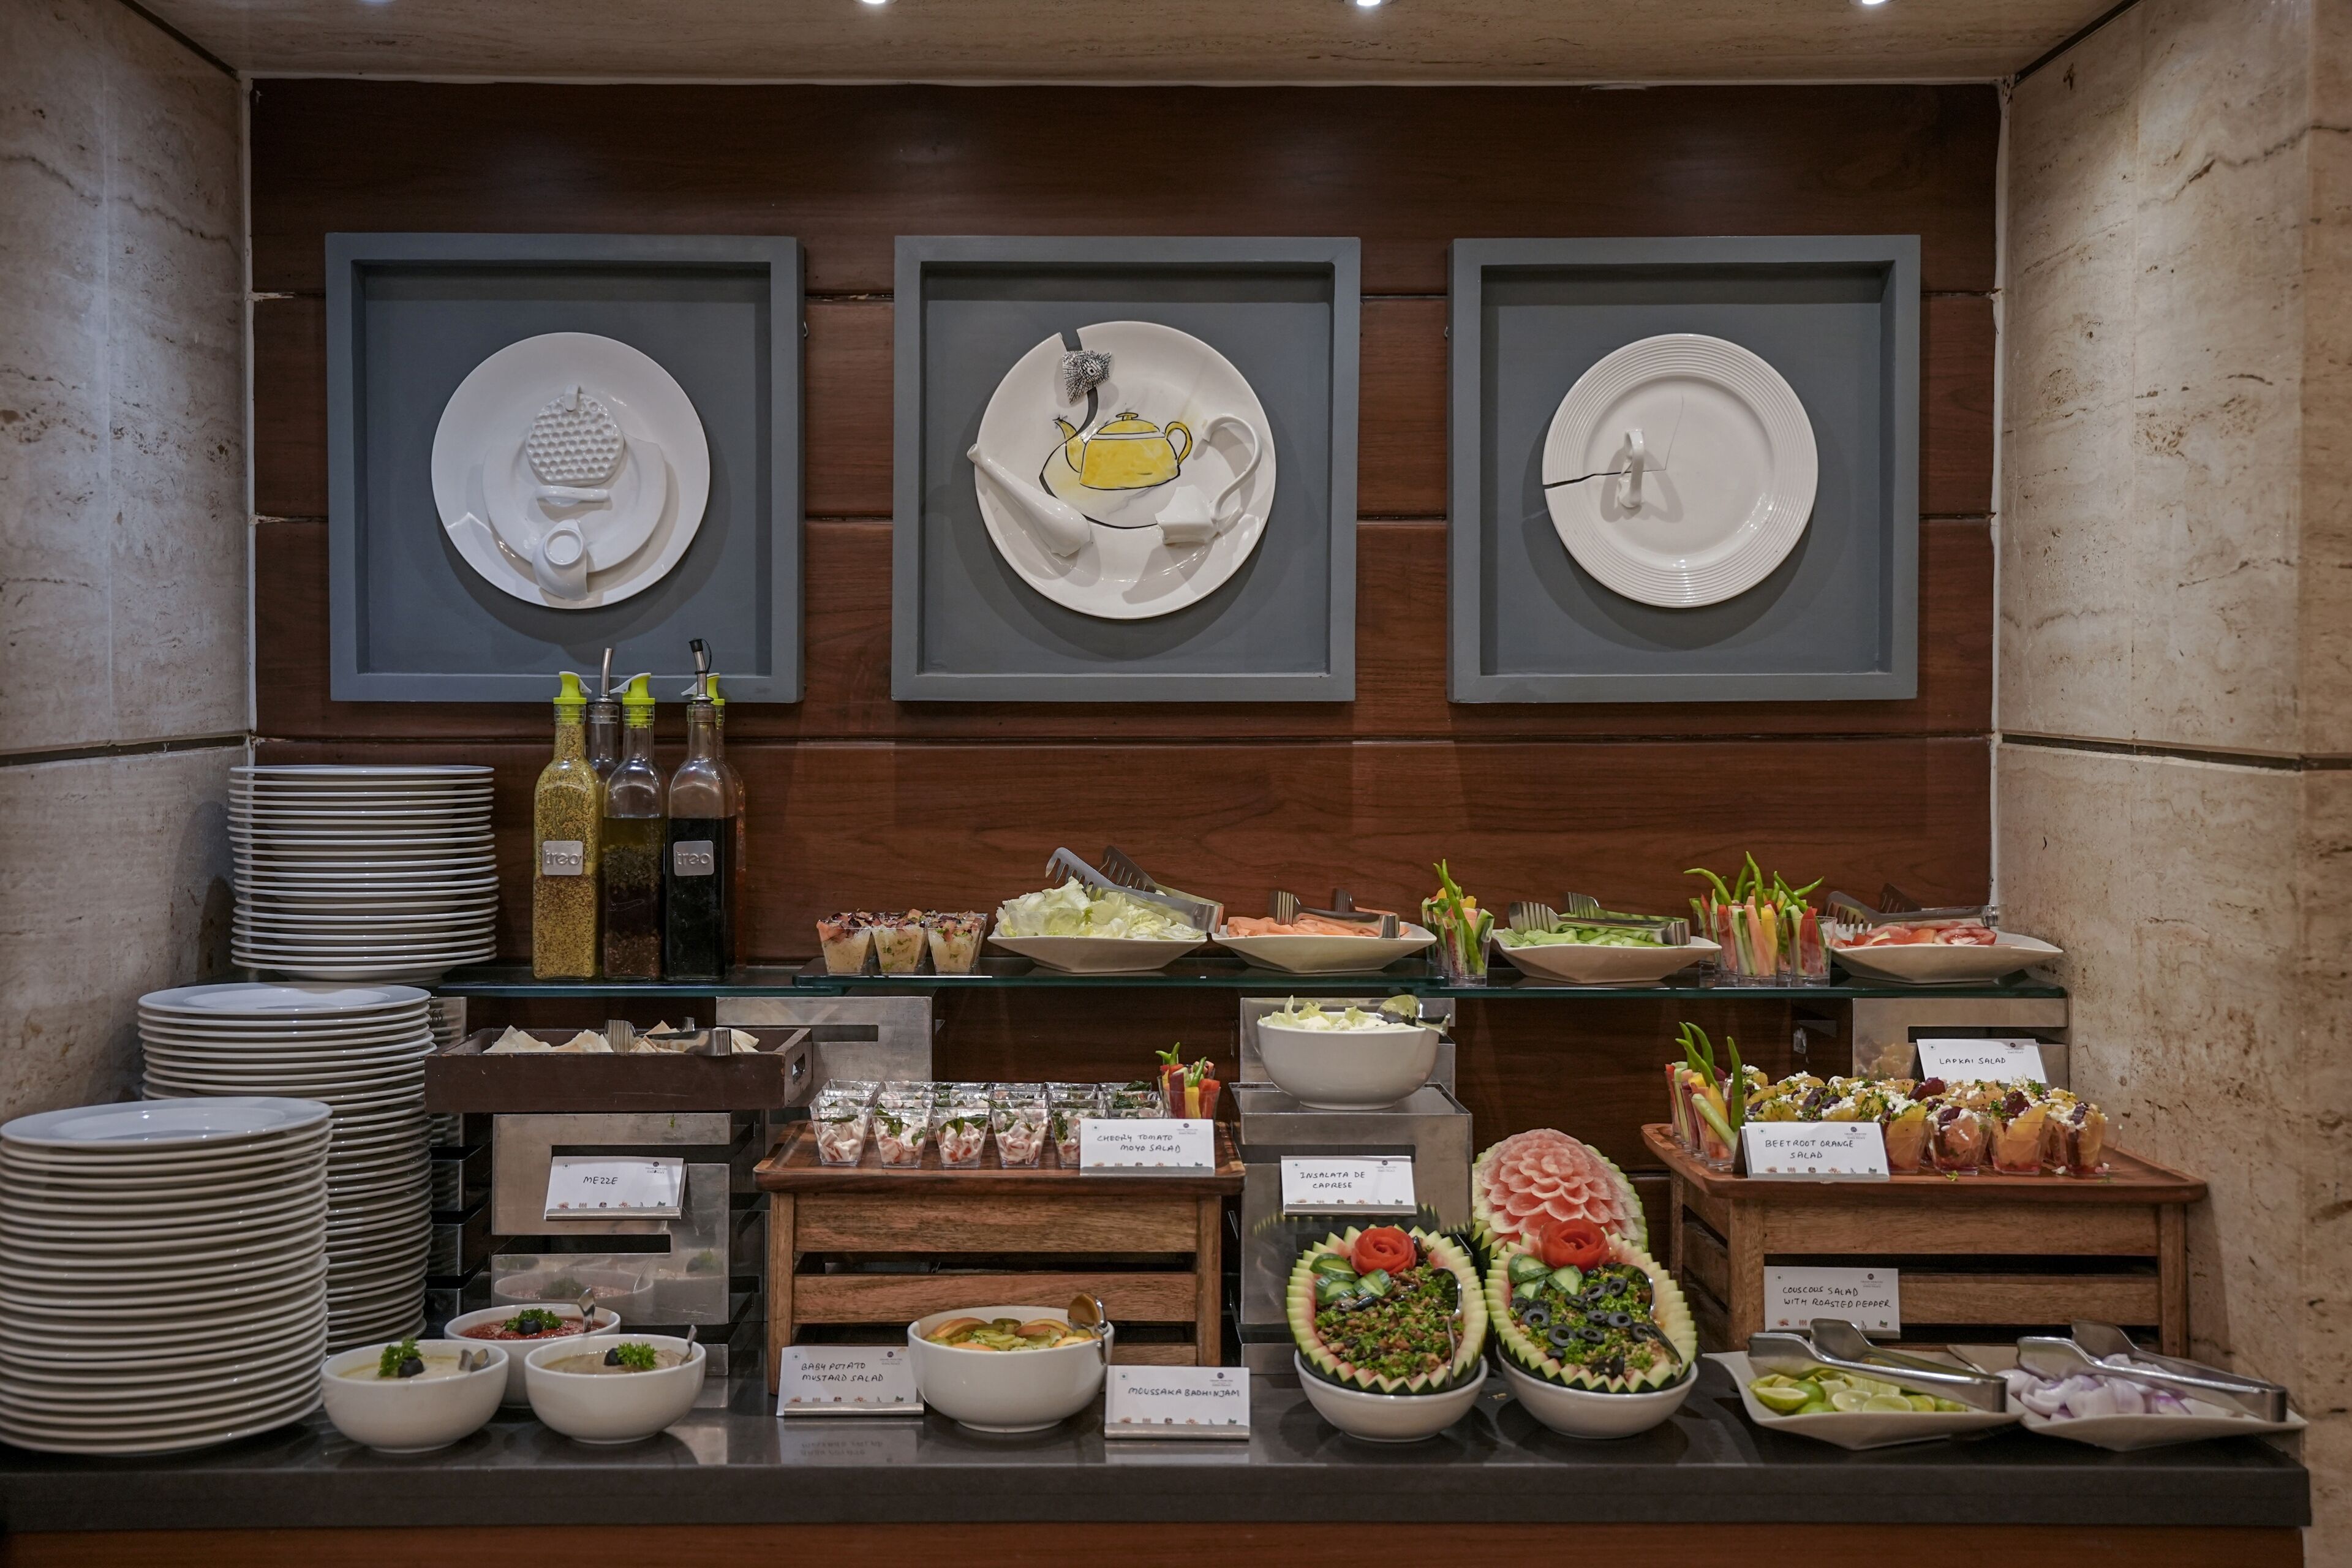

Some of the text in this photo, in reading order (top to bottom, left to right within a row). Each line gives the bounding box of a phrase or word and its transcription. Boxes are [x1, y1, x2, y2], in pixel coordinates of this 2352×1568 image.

[1149, 1144, 1181, 1153] SALAD
[1828, 1287, 1858, 1297] SALAD
[1812, 1298, 1853, 1308] ROASTED
[1855, 1299, 1891, 1308] PEPPER
[801, 1362, 865, 1371] BABY POTATO
[1128, 1387, 1240, 1397] MOUSSAKA BADHINJAM
